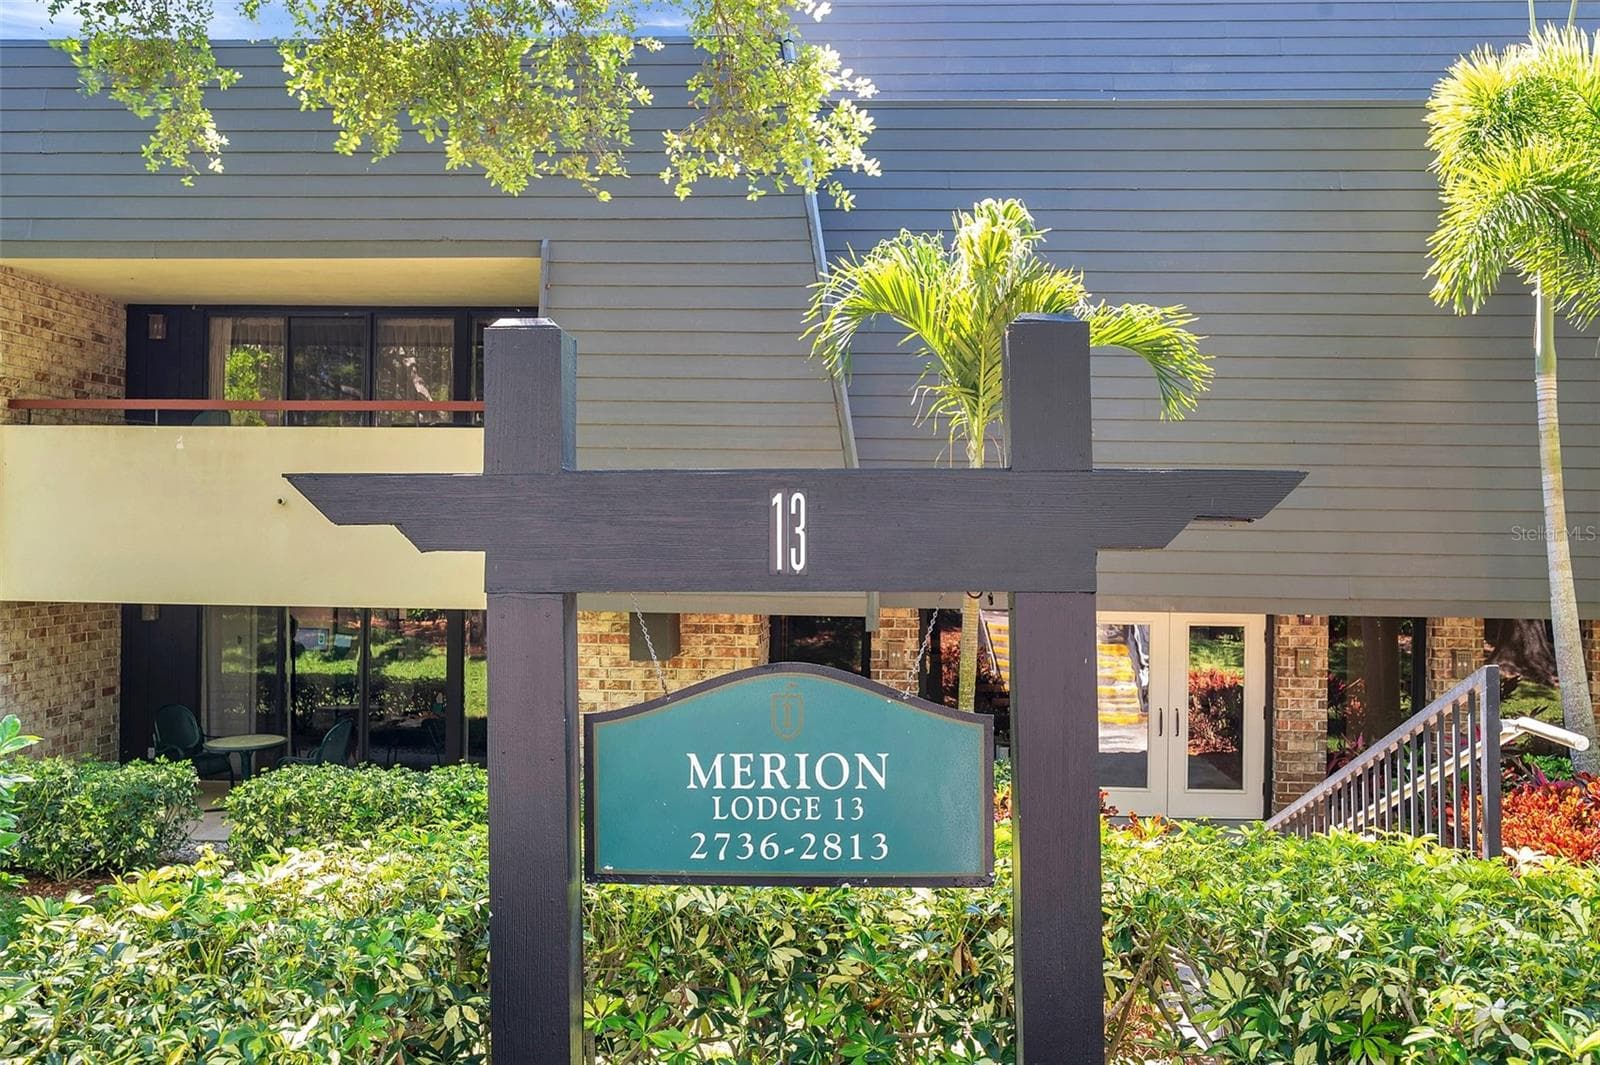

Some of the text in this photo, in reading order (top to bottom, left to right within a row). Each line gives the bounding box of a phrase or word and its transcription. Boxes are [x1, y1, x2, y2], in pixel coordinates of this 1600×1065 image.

[771, 492, 806, 571] 13
[686, 752, 889, 791] MERION
[712, 796, 864, 821] LODGE 13
[689, 832, 889, 862] 2736-2813
